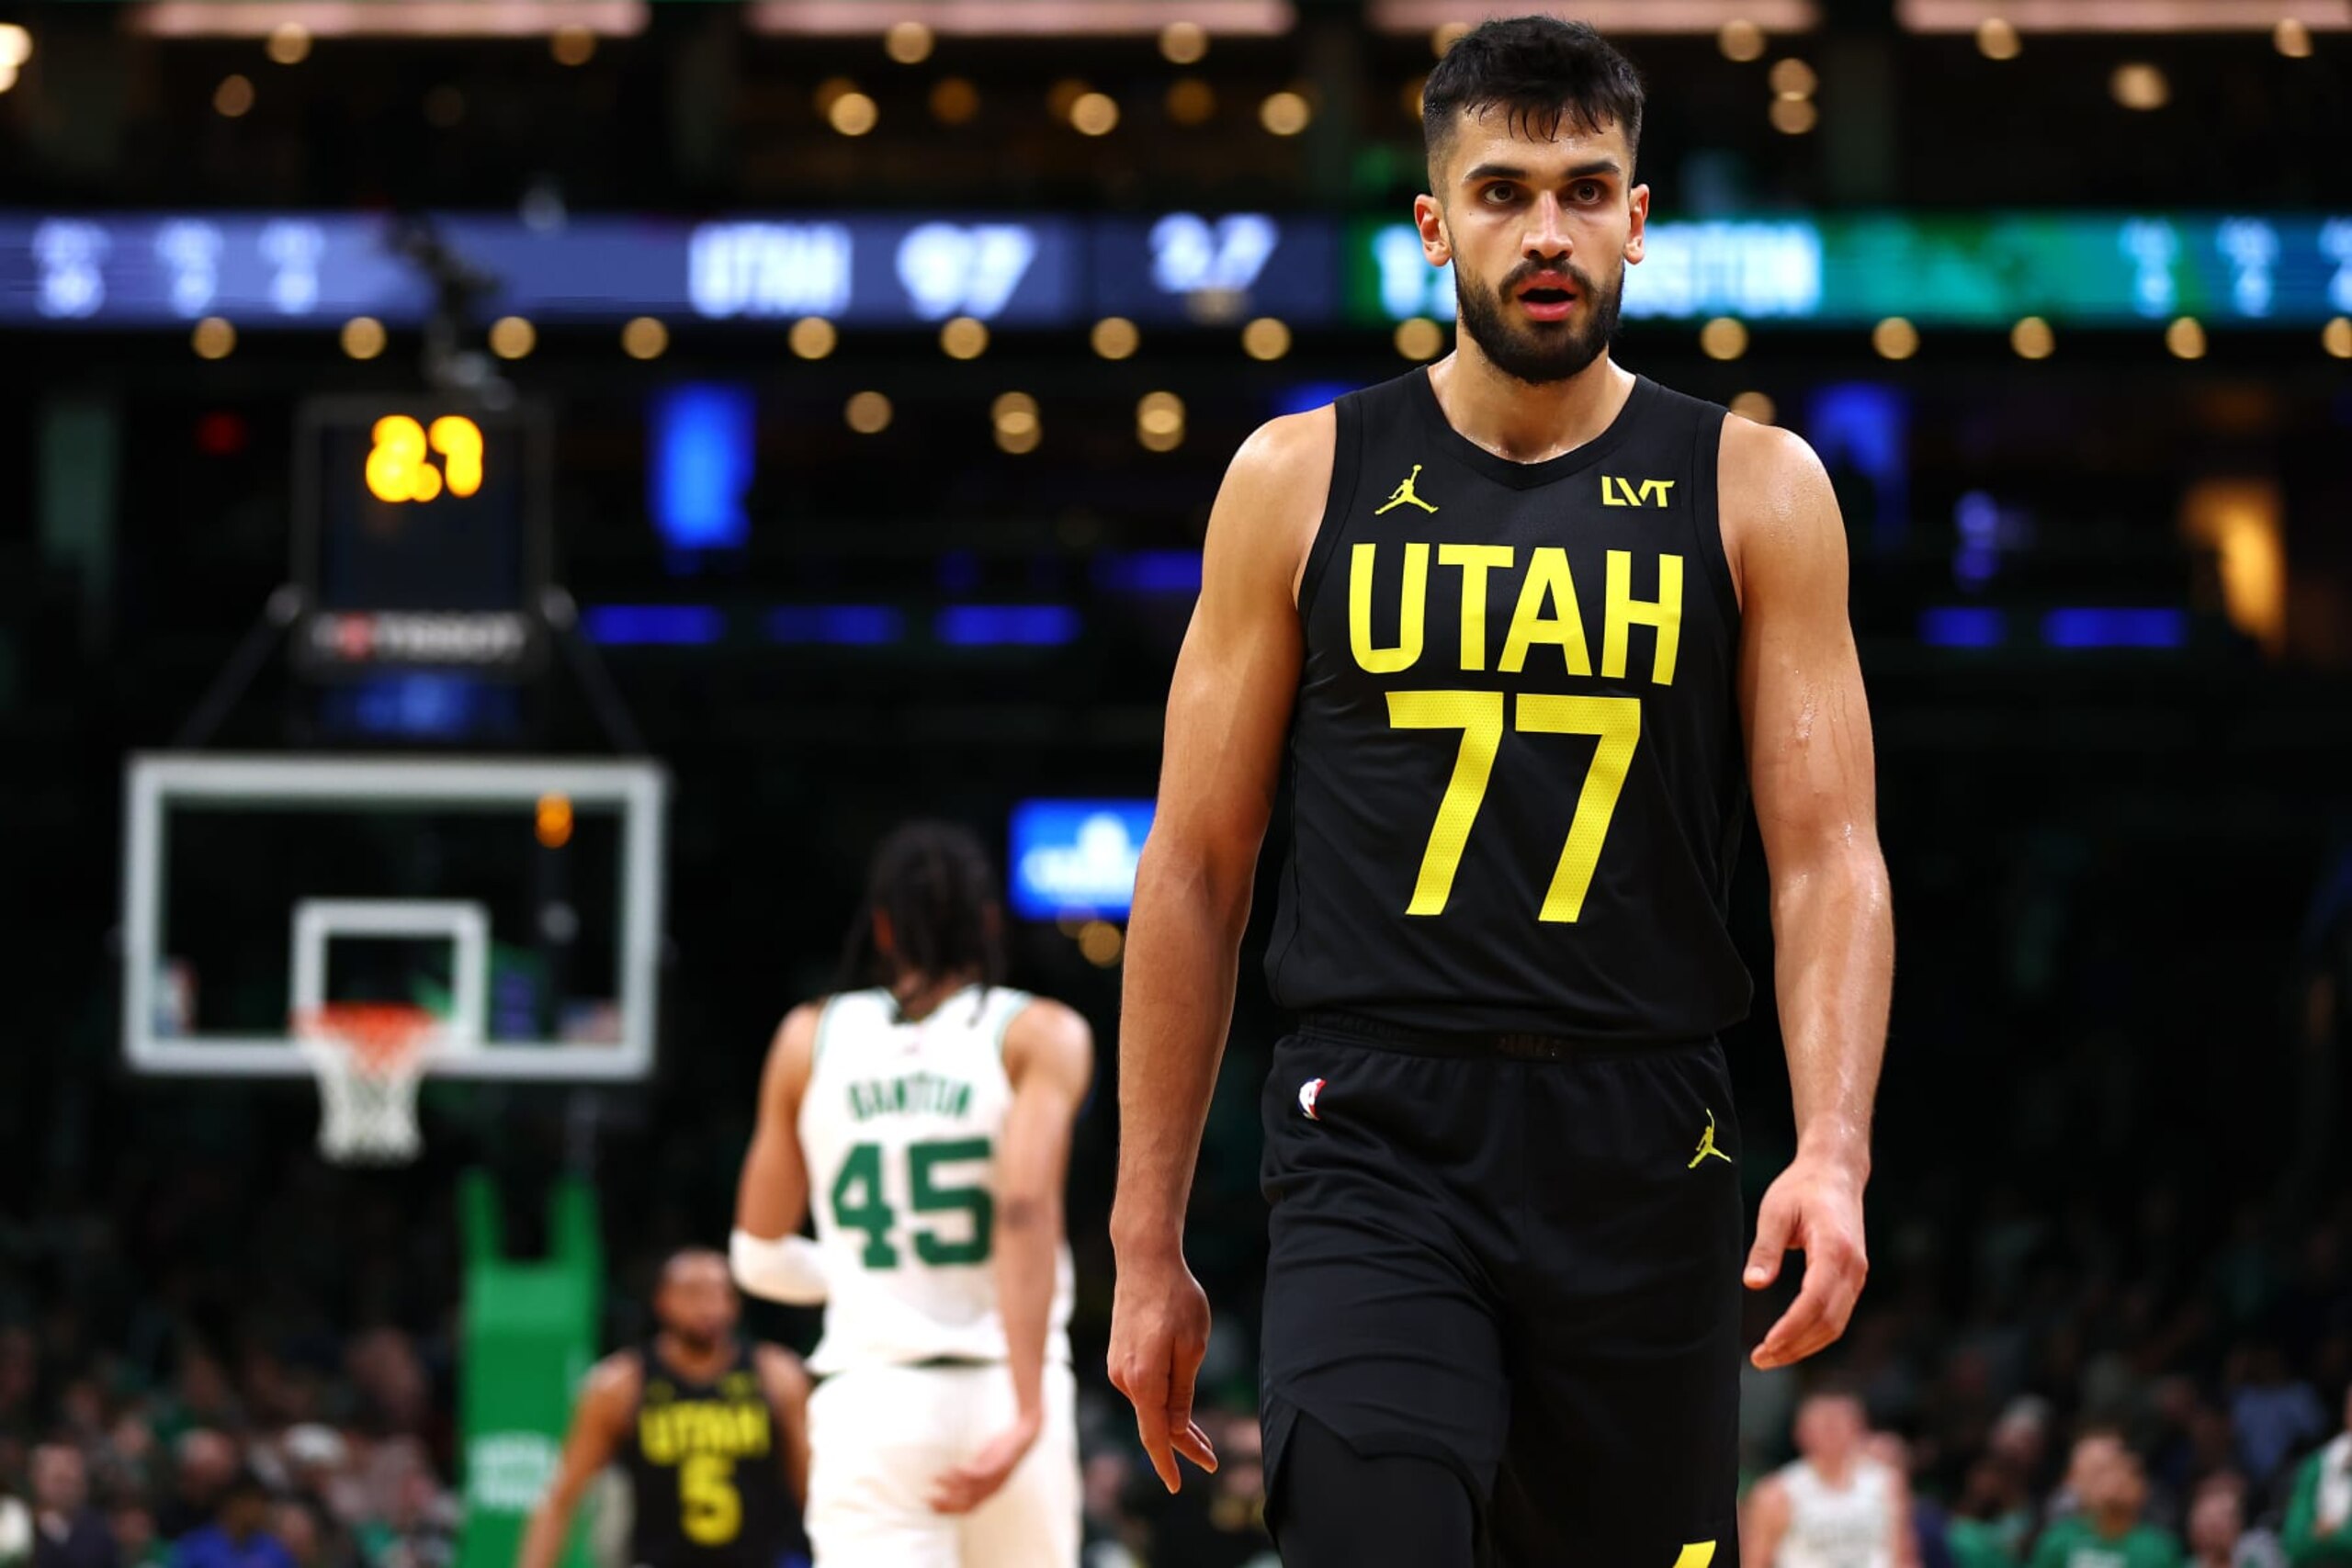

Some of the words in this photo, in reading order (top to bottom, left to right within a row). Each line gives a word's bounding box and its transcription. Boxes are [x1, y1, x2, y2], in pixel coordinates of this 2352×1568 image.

[1601, 475, 1676, 508] LVT
[1349, 542, 1684, 686] UTAH
[1385, 690, 1642, 923] 77
[830, 1136, 994, 1271] 45
[639, 1400, 772, 1466] UTAH
[679, 1456, 742, 1546] 5
